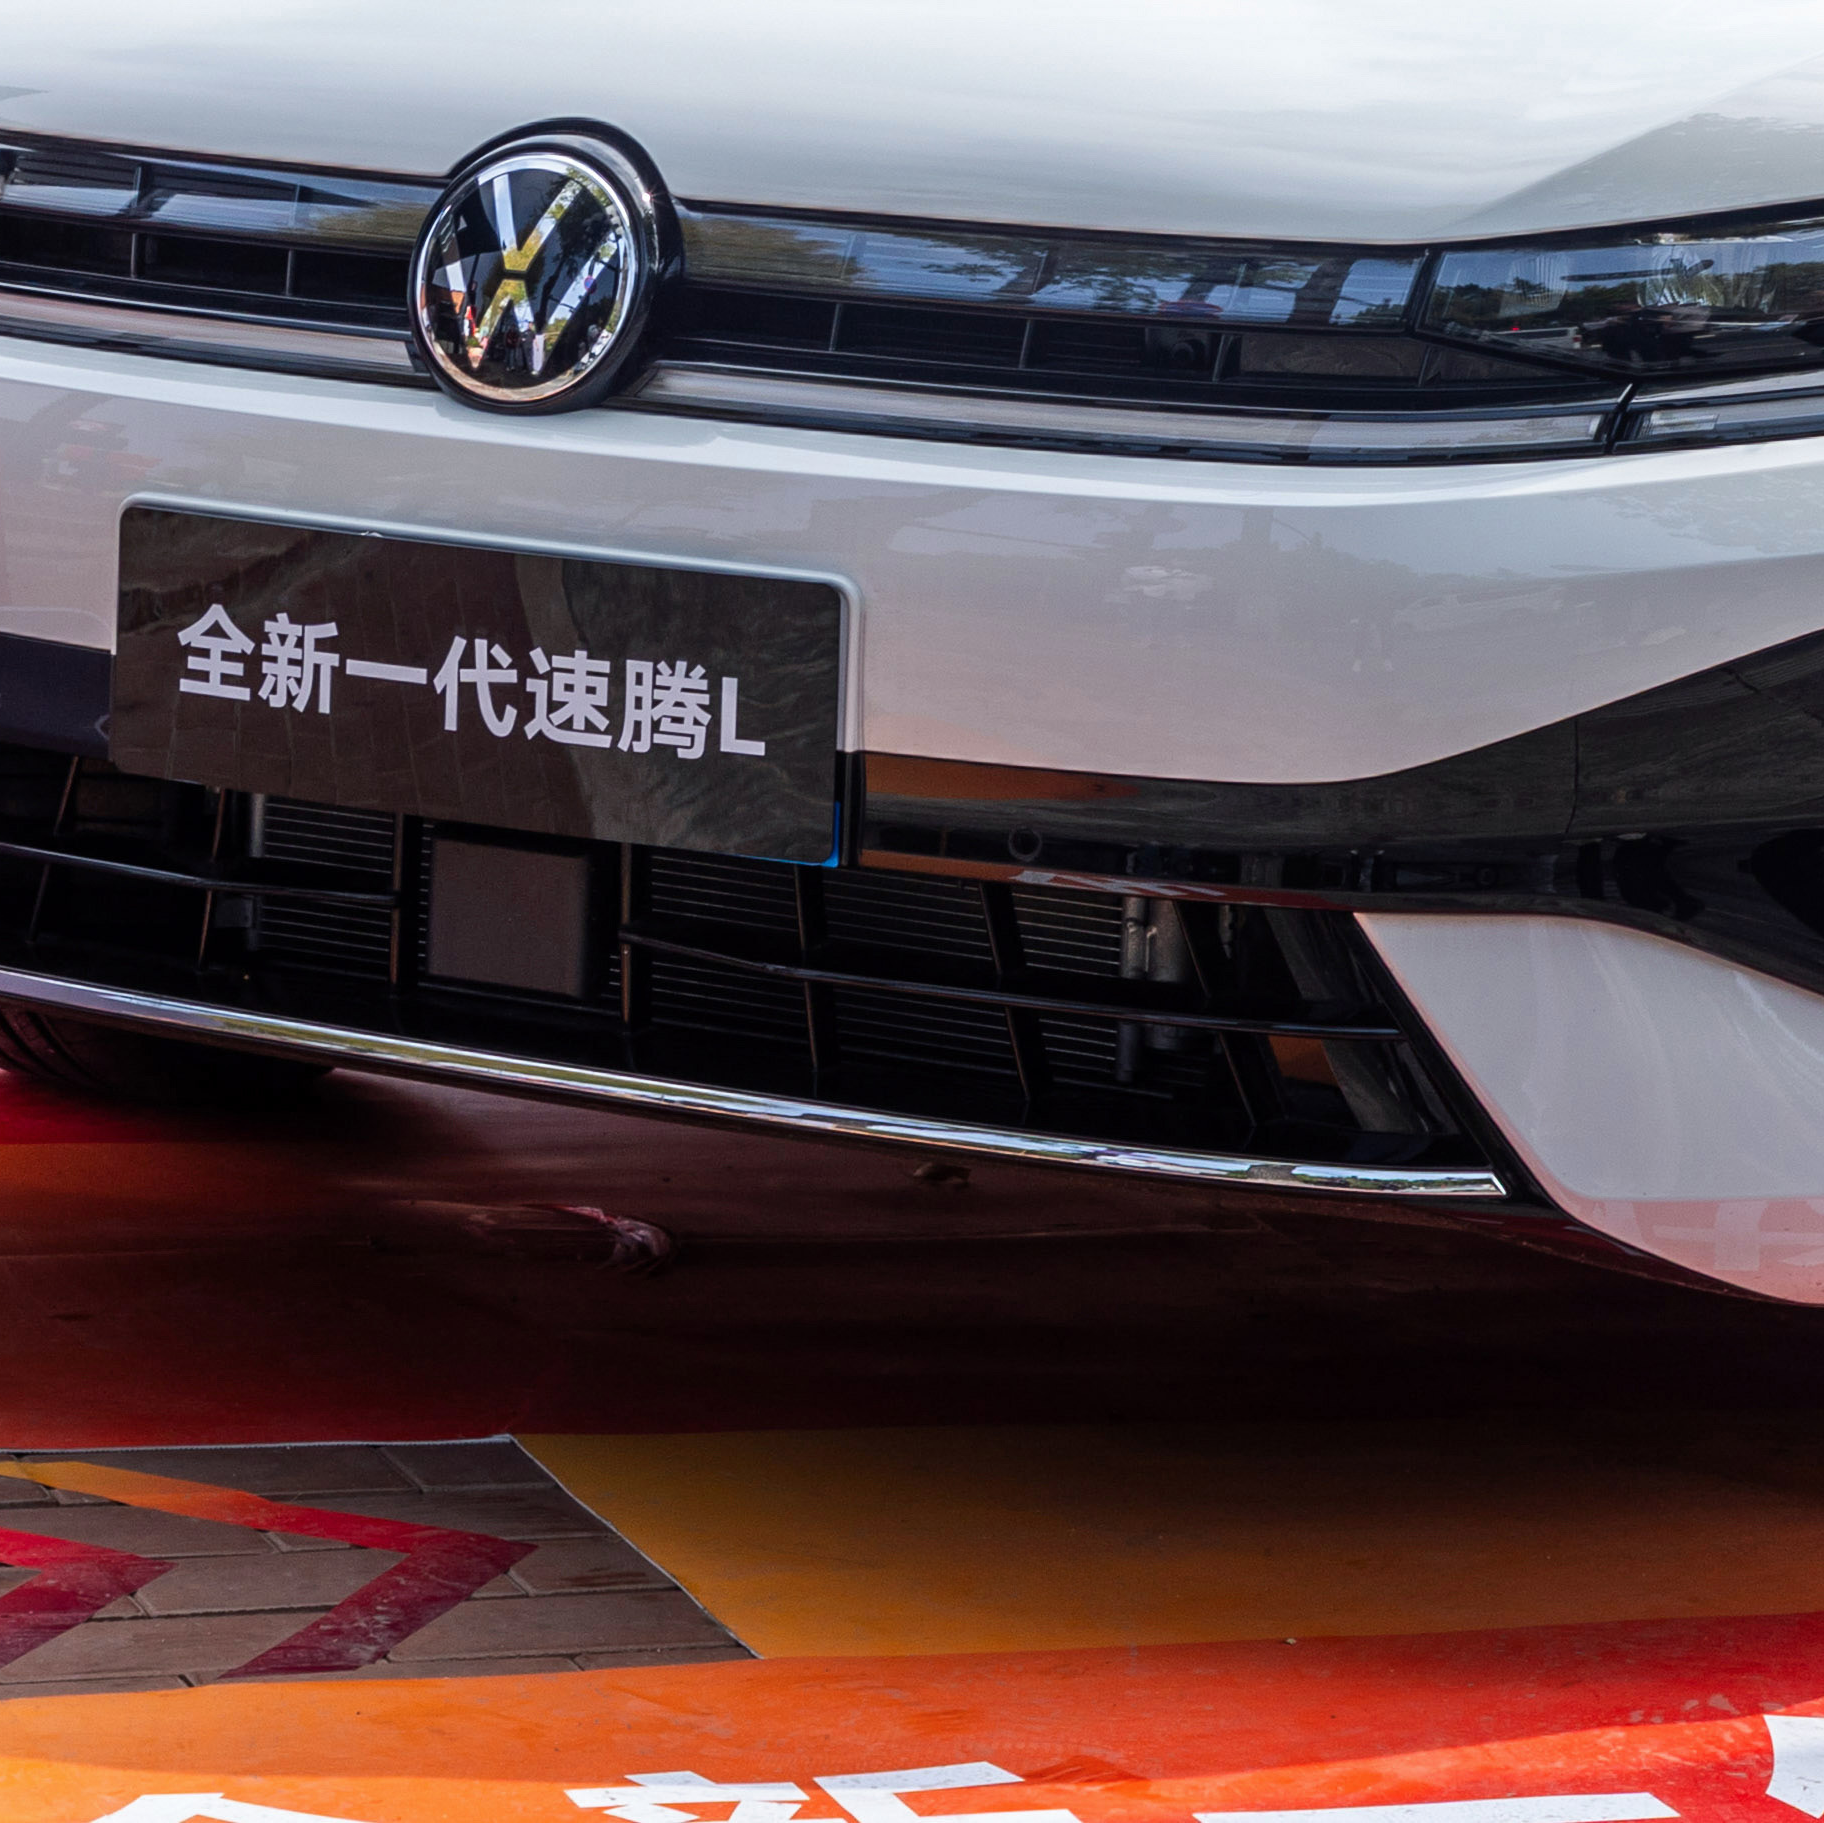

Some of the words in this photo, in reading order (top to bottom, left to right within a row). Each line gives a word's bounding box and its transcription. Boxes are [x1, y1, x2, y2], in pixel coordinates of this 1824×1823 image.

[177, 603, 767, 760] 全新一代速腾L
